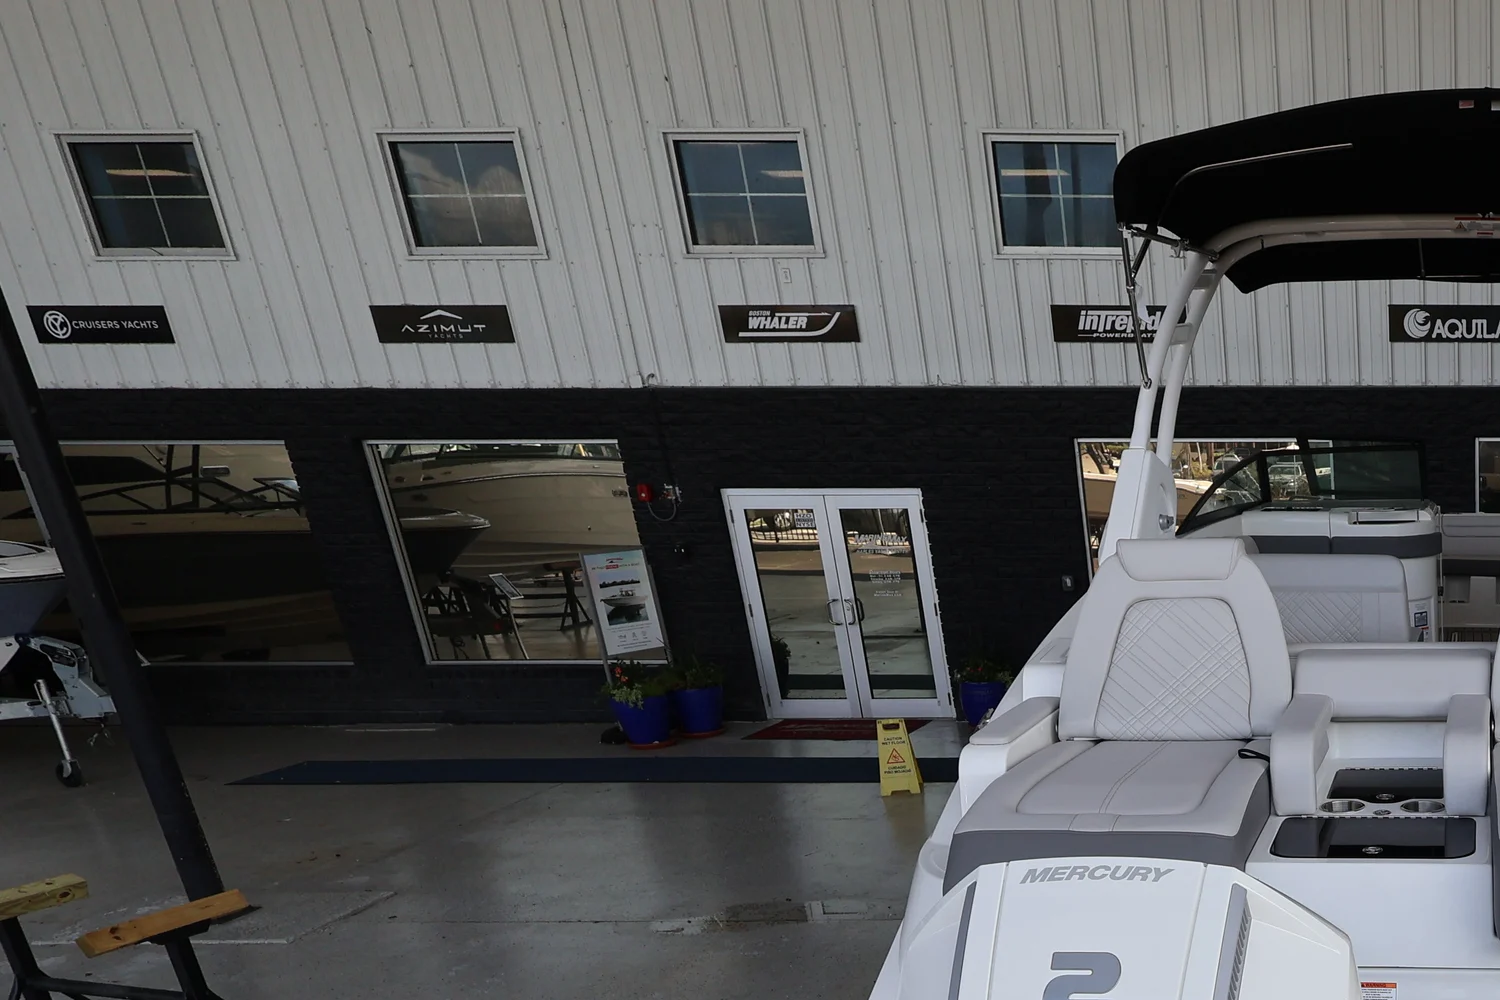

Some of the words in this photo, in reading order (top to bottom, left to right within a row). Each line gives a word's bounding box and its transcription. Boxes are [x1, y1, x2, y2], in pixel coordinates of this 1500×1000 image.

[72, 320, 120, 329] CRUISERS
[121, 320, 159, 329] YACHTS
[748, 316, 808, 329] WHALER
[401, 324, 486, 333] AZIMUT
[1019, 865, 1175, 885] MERCURY
